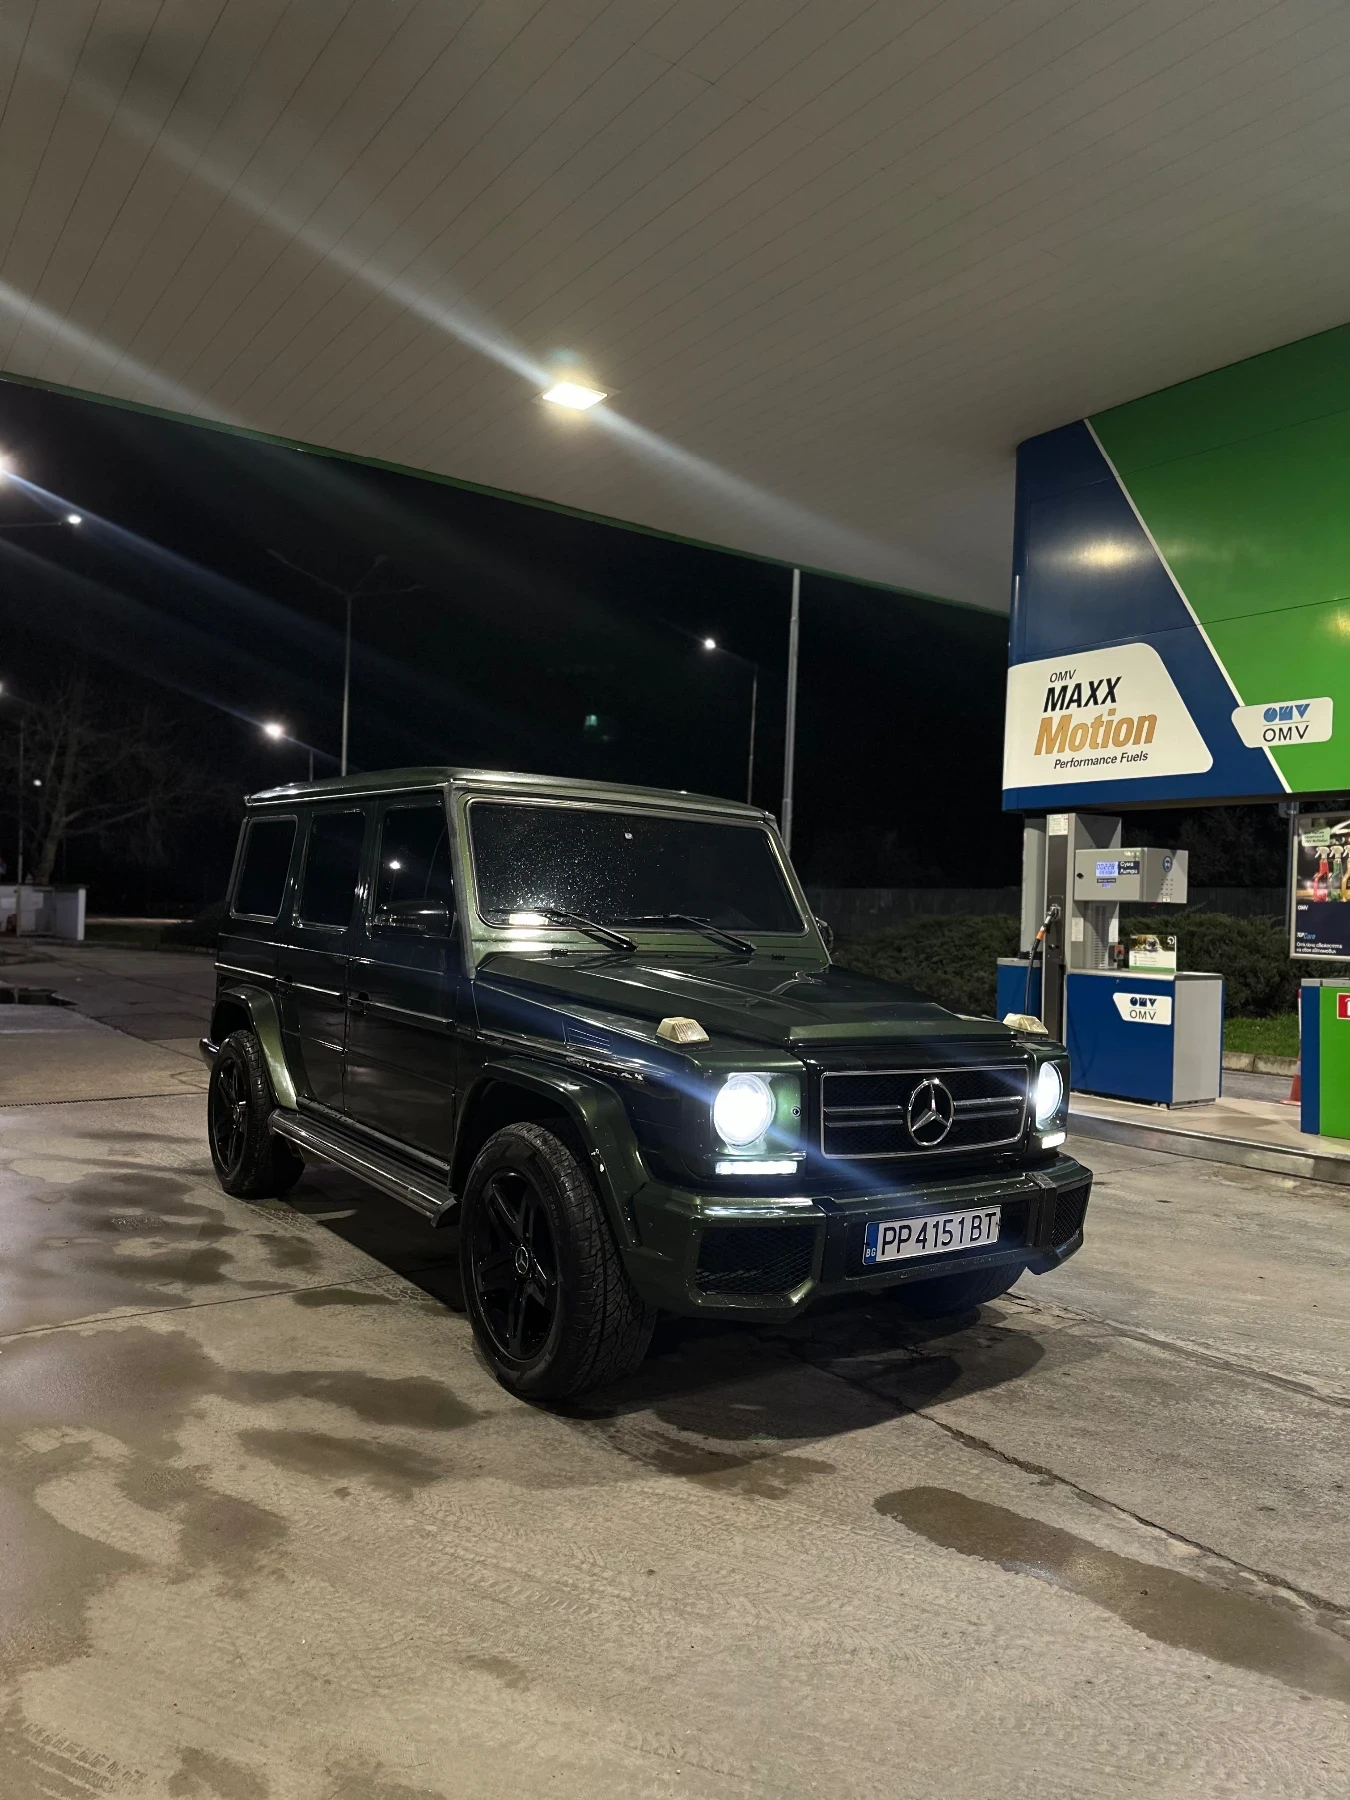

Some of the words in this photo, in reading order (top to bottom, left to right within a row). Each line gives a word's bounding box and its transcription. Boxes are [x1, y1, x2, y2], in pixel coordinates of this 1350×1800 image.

[1049, 669, 1076, 683] OMV
[1043, 676, 1122, 713] MAXX
[1033, 708, 1158, 756] Motion
[1262, 725, 1309, 743] OMV
[1053, 754, 1117, 769] Performance
[1120, 751, 1149, 764] Fuels
[1129, 1009, 1157, 1020] OMV
[865, 1248, 877, 1257] BG
